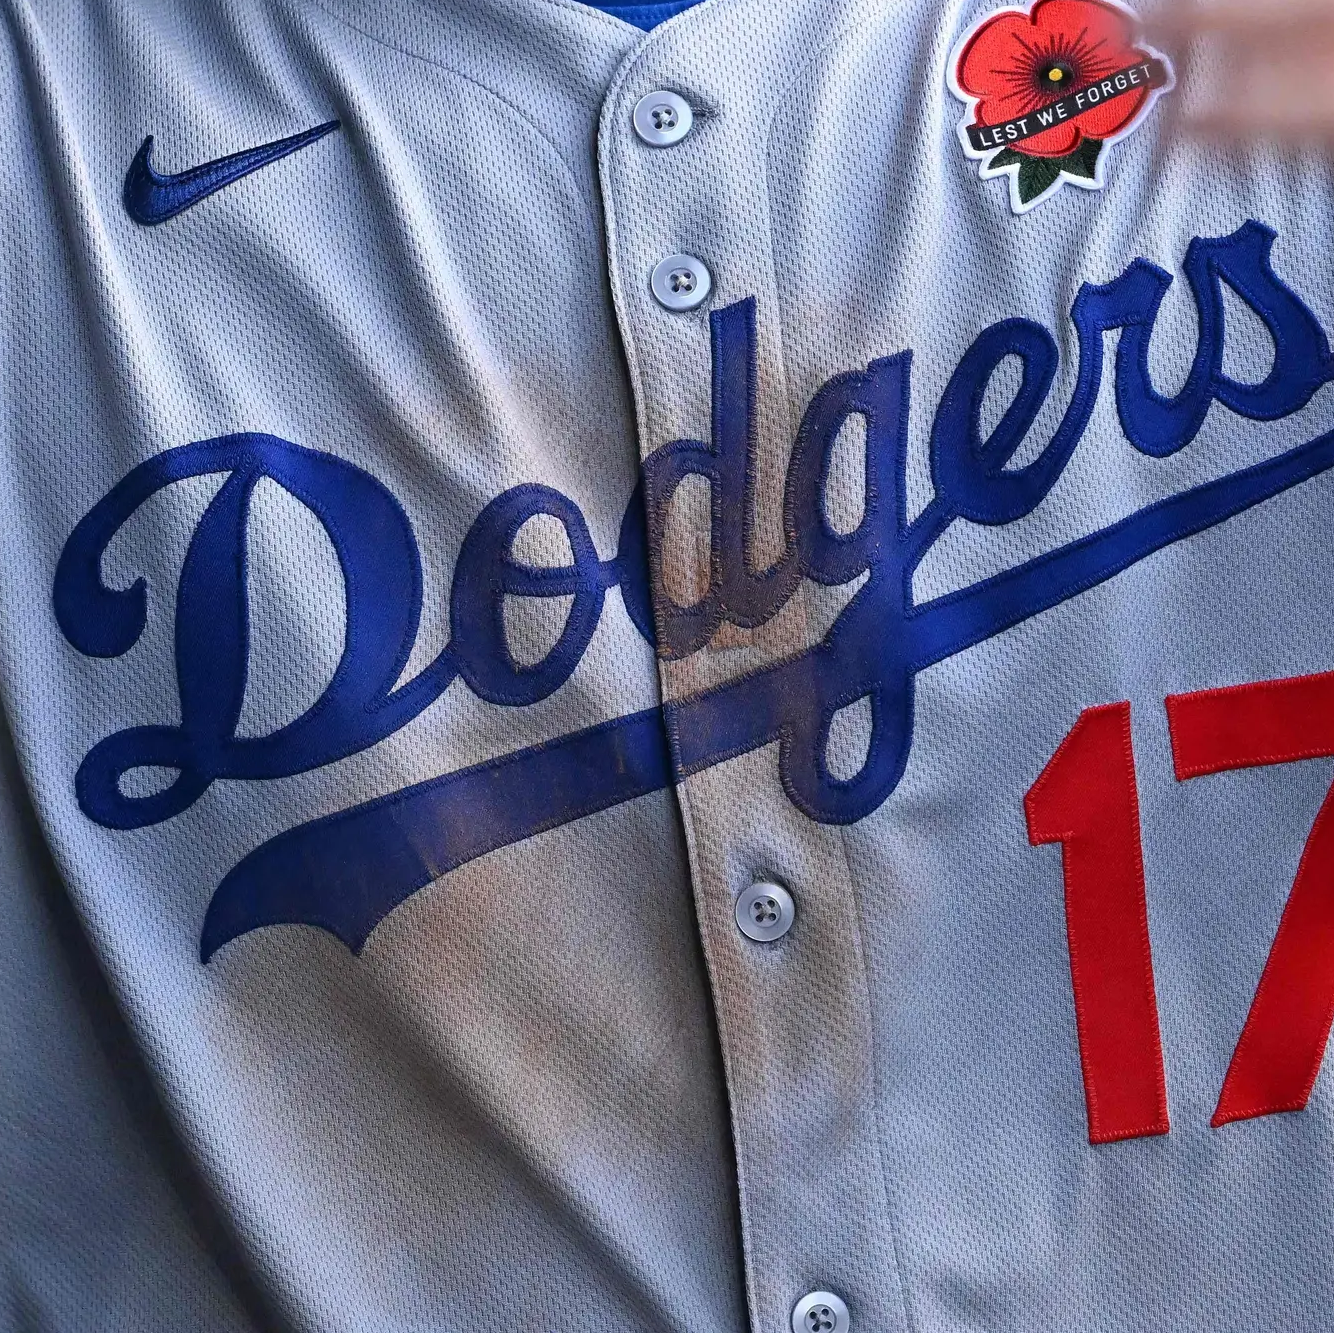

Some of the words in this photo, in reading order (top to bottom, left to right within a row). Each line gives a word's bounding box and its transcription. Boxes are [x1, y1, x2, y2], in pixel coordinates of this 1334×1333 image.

[978, 120, 1029, 148] LEST
[1036, 103, 1068, 126] WE
[1074, 63, 1152, 113] FORGET
